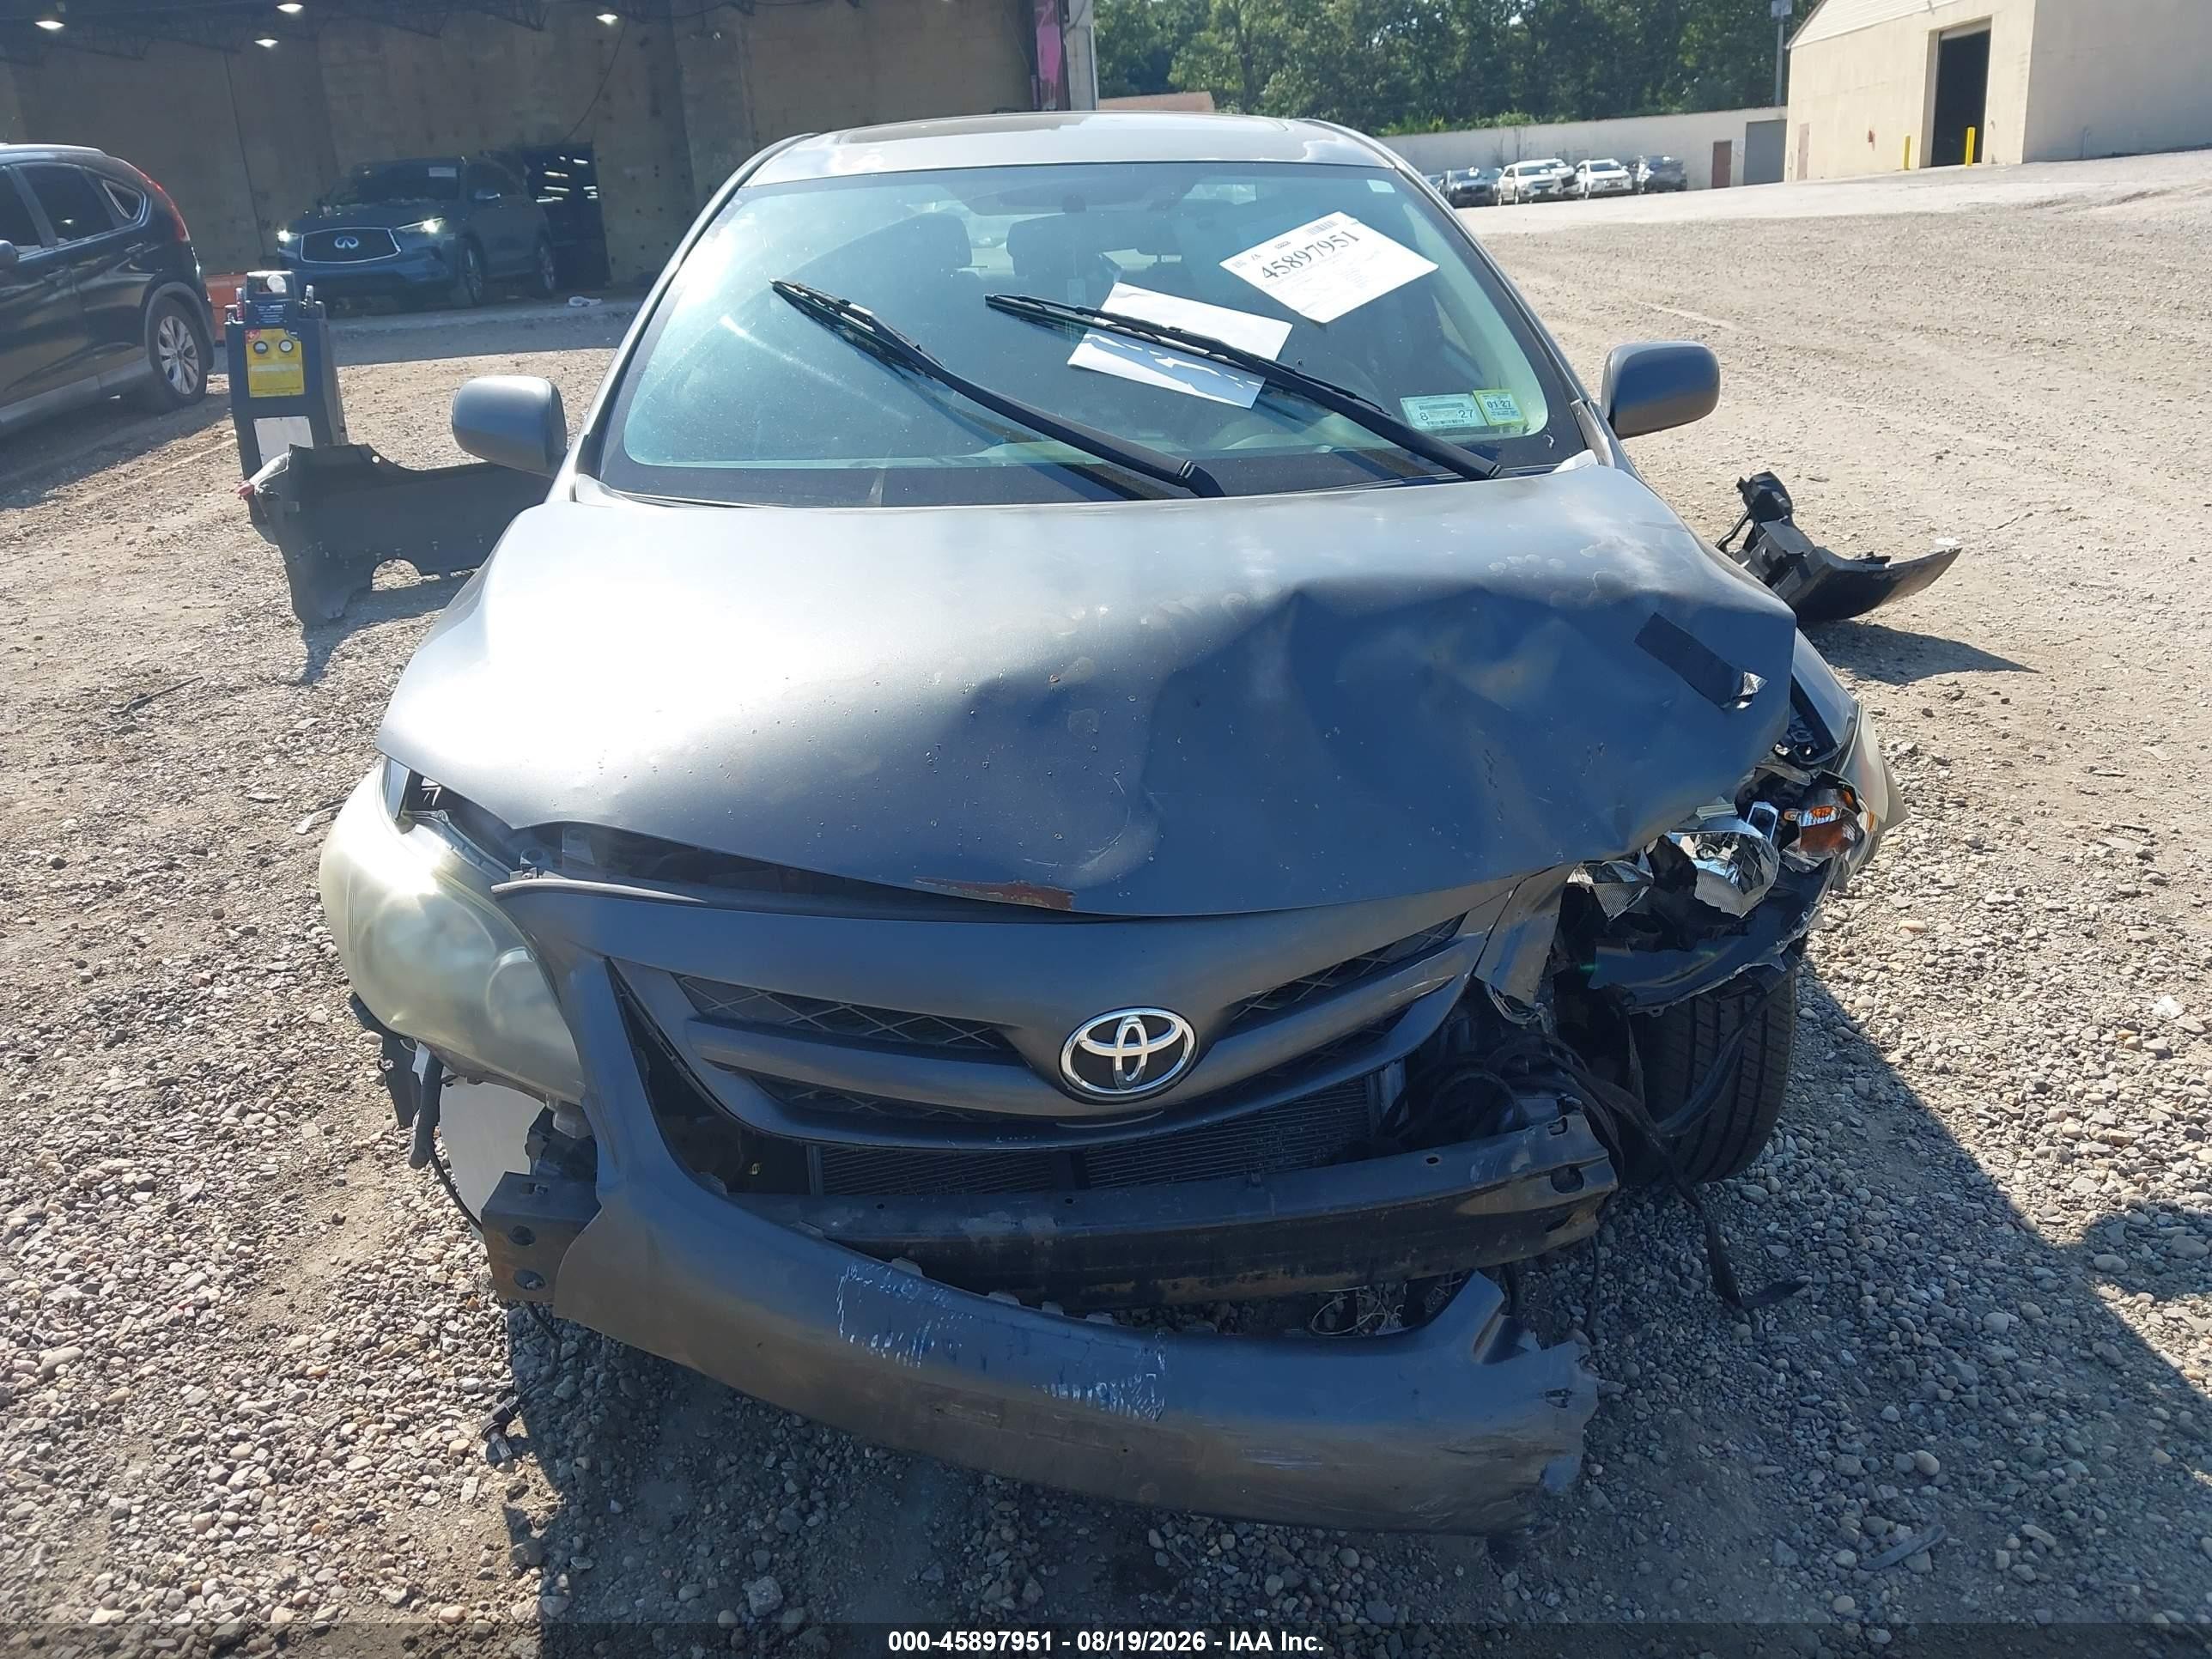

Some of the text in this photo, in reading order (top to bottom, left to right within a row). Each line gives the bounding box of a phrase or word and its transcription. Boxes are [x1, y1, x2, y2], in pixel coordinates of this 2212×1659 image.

[1261, 230, 1360, 279] 45897951
[1419, 409, 1474, 421] 8 27
